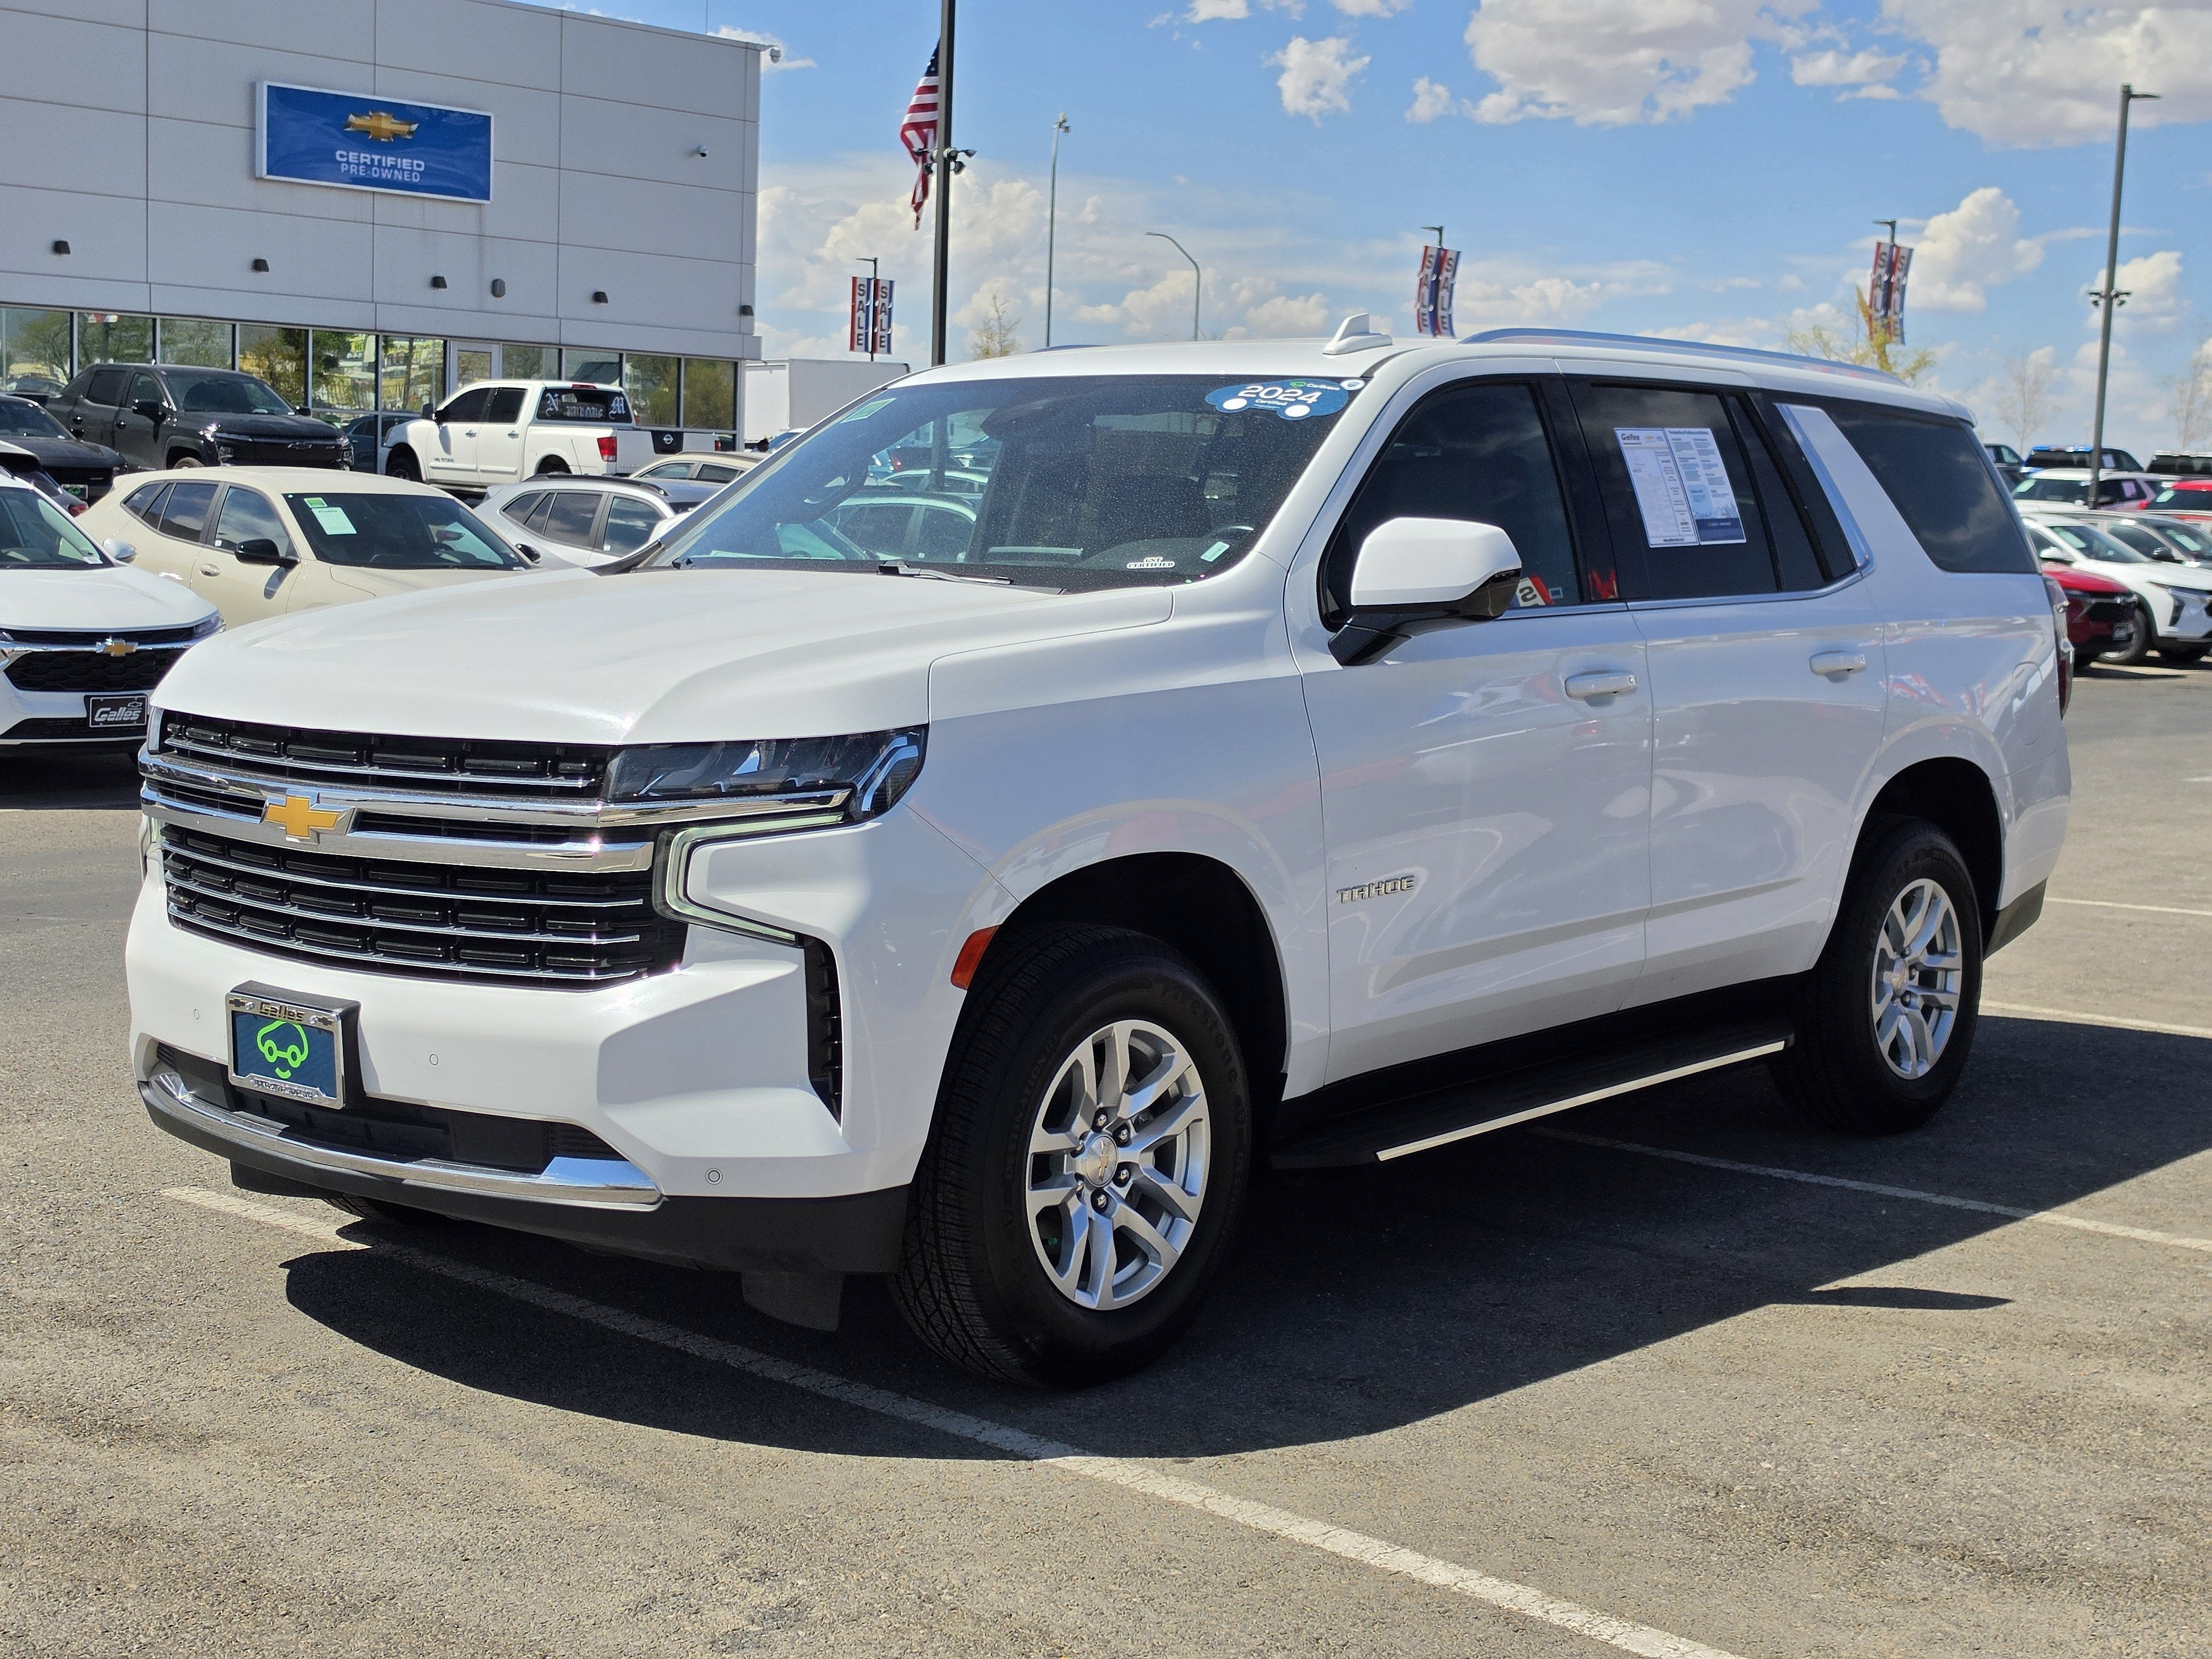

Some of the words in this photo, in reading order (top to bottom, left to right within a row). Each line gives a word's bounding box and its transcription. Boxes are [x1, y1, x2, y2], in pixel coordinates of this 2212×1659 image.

[336, 150, 425, 171] CERTIFIED
[341, 164, 420, 182] PRE-OWNED
[1421, 254, 1434, 328] SALE
[1440, 257, 1454, 331] SALE
[857, 284, 865, 346] SALE
[879, 286, 888, 348] SALE
[1238, 385, 1322, 404] 2024
[94, 707, 142, 722] Galles
[1337, 874, 1416, 904] TAHOE
[259, 1001, 306, 1021] Galles
